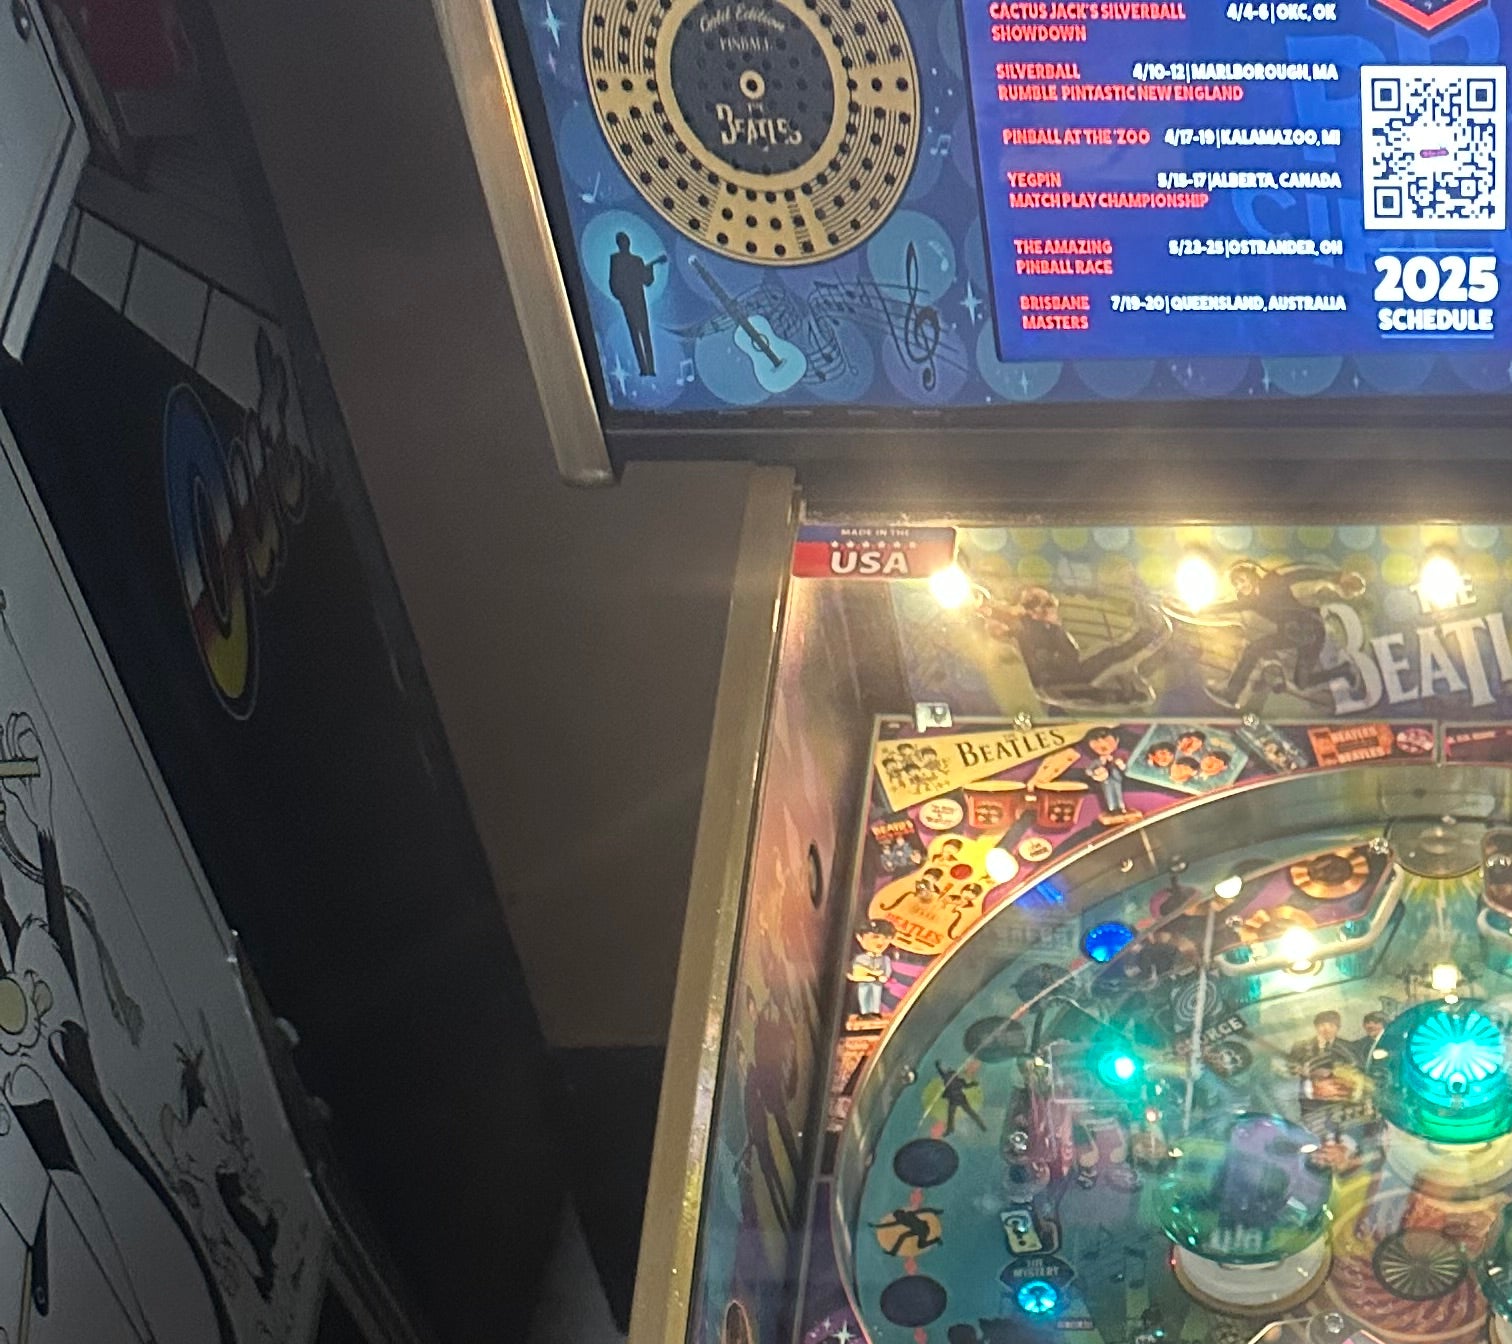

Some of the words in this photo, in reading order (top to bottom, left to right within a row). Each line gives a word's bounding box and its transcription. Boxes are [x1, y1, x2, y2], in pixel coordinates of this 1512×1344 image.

[989, 3, 1048, 19] CACTUS
[1101, 3, 1186, 20] SILVERBALL
[991, 25, 1087, 41] SHOWDOWN
[996, 63, 1080, 79] SILVERBALL
[998, 85, 1058, 101] RUMBLE
[1061, 85, 1135, 101] PINTASTIC
[1137, 85, 1173, 101] NEW
[1174, 85, 1243, 101] ENGLAND
[1003, 128, 1062, 145] PINBALL
[1063, 128, 1083, 145] AT
[1084, 128, 1112, 145] THE
[1007, 172, 1062, 188] YEGPIN
[1098, 193, 1209, 208] CHAMPIONSHIP
[1014, 239, 1044, 255] THE
[1044, 239, 1112, 255] AMAZING
[1016, 259, 1074, 275] PINBALL
[1075, 260, 1113, 275] RACE
[1374, 256, 1499, 302] 2025
[1020, 295, 1090, 311] BRISBANE
[1022, 315, 1088, 330] MASTERS
[1379, 308, 1494, 332] SCHEDULE
[831, 544, 909, 576] USA
[956, 729, 1065, 767] BEATLES
